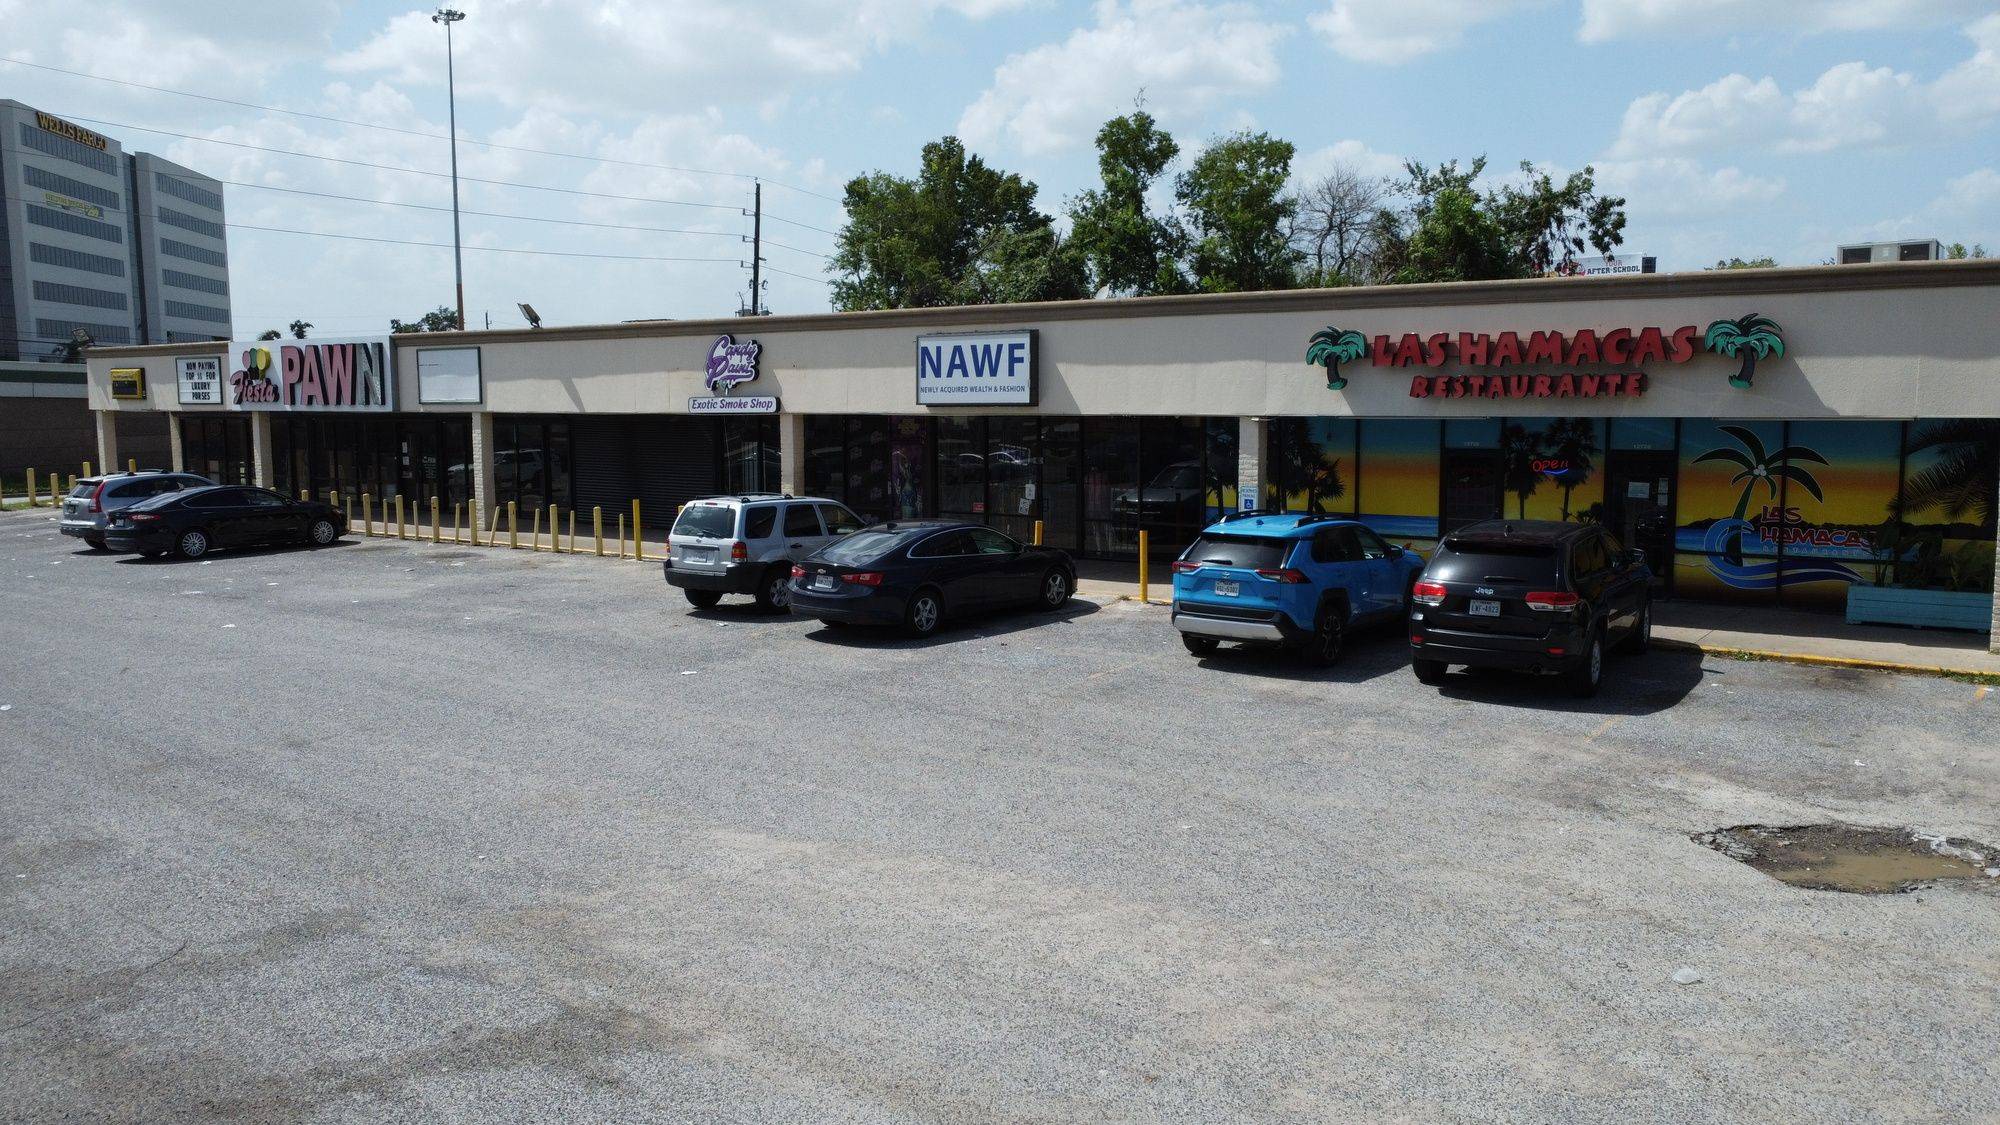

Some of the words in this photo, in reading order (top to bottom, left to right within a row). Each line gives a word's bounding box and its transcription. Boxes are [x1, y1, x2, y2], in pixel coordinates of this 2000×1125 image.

[37, 111, 76, 140] WELLS
[74, 127, 108, 151] FARGO
[1587, 267, 1610, 275] AFTER
[1372, 332, 1449, 368] LAS
[1458, 325, 1698, 367] HAMACAS
[186, 362, 197, 370] NOW
[198, 362, 216, 370] PAYING
[920, 343, 1025, 378] NAWF
[185, 372, 194, 380] TOP
[206, 371, 216, 380] FOR
[280, 342, 386, 406] PAWN
[191, 382, 210, 390] LUXURY
[230, 369, 280, 405] Fiesta
[1409, 374, 1645, 399] RESTAURANTE
[192, 392, 210, 400] PURSES
[692, 399, 718, 409] Exotic
[719, 399, 748, 409] Smoke
[750, 399, 773, 410] Shop
[1761, 505, 1801, 524] LAS
